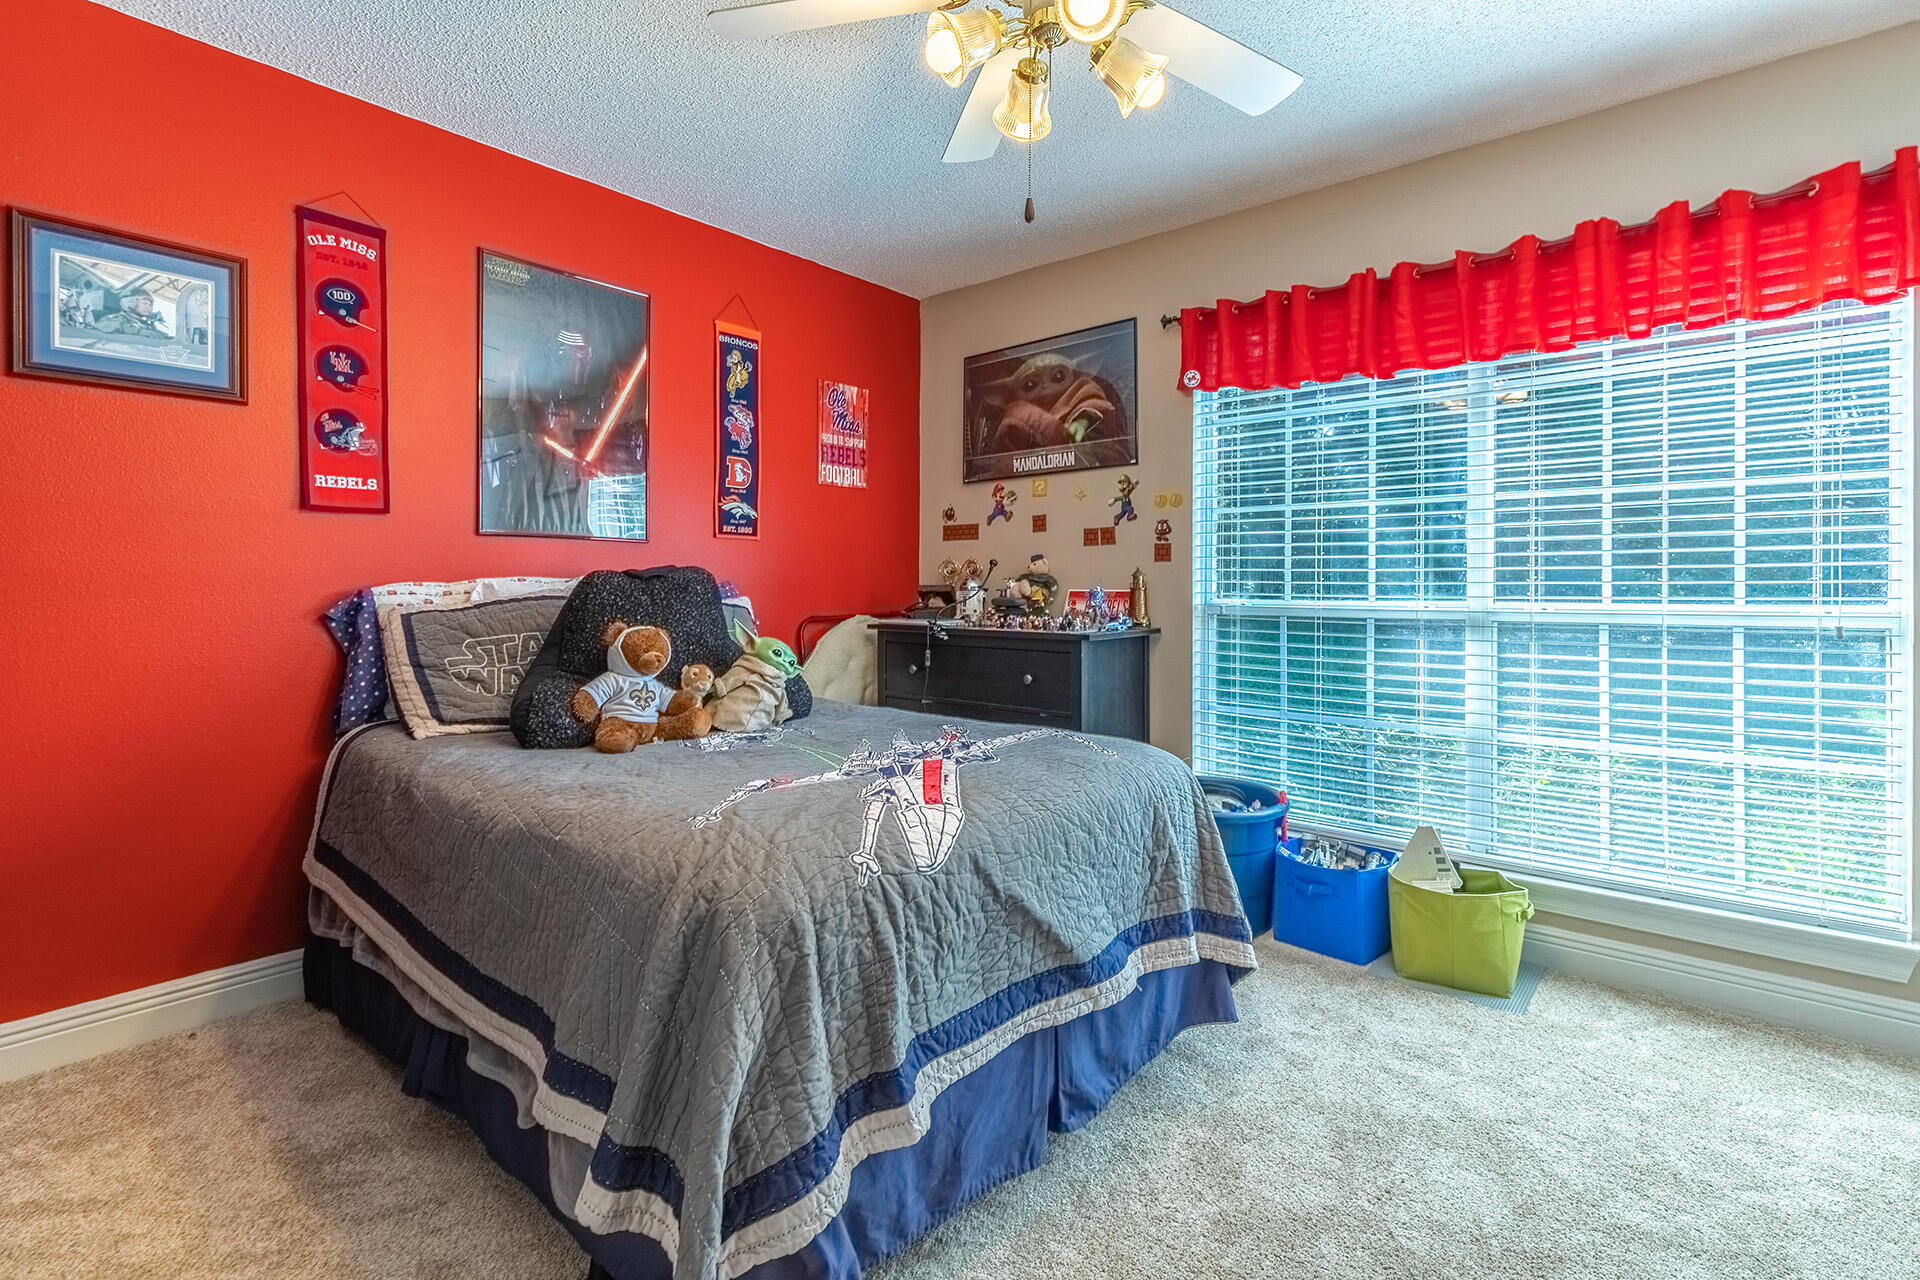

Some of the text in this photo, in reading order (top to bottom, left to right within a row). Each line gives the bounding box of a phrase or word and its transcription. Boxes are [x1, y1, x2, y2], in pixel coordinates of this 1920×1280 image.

[307, 234, 377, 262] OLE MISS
[316, 251, 340, 264] EST.
[332, 289, 351, 301] 100
[718, 334, 759, 351] BRONCOS
[827, 387, 847, 410] Ole
[832, 409, 861, 434] Miss
[821, 444, 867, 468] REBELS
[1013, 451, 1075, 473] MANDALORIAN
[314, 474, 378, 490] REBELS
[821, 464, 865, 487] FOOTBALL
[445, 632, 545, 669] STA
